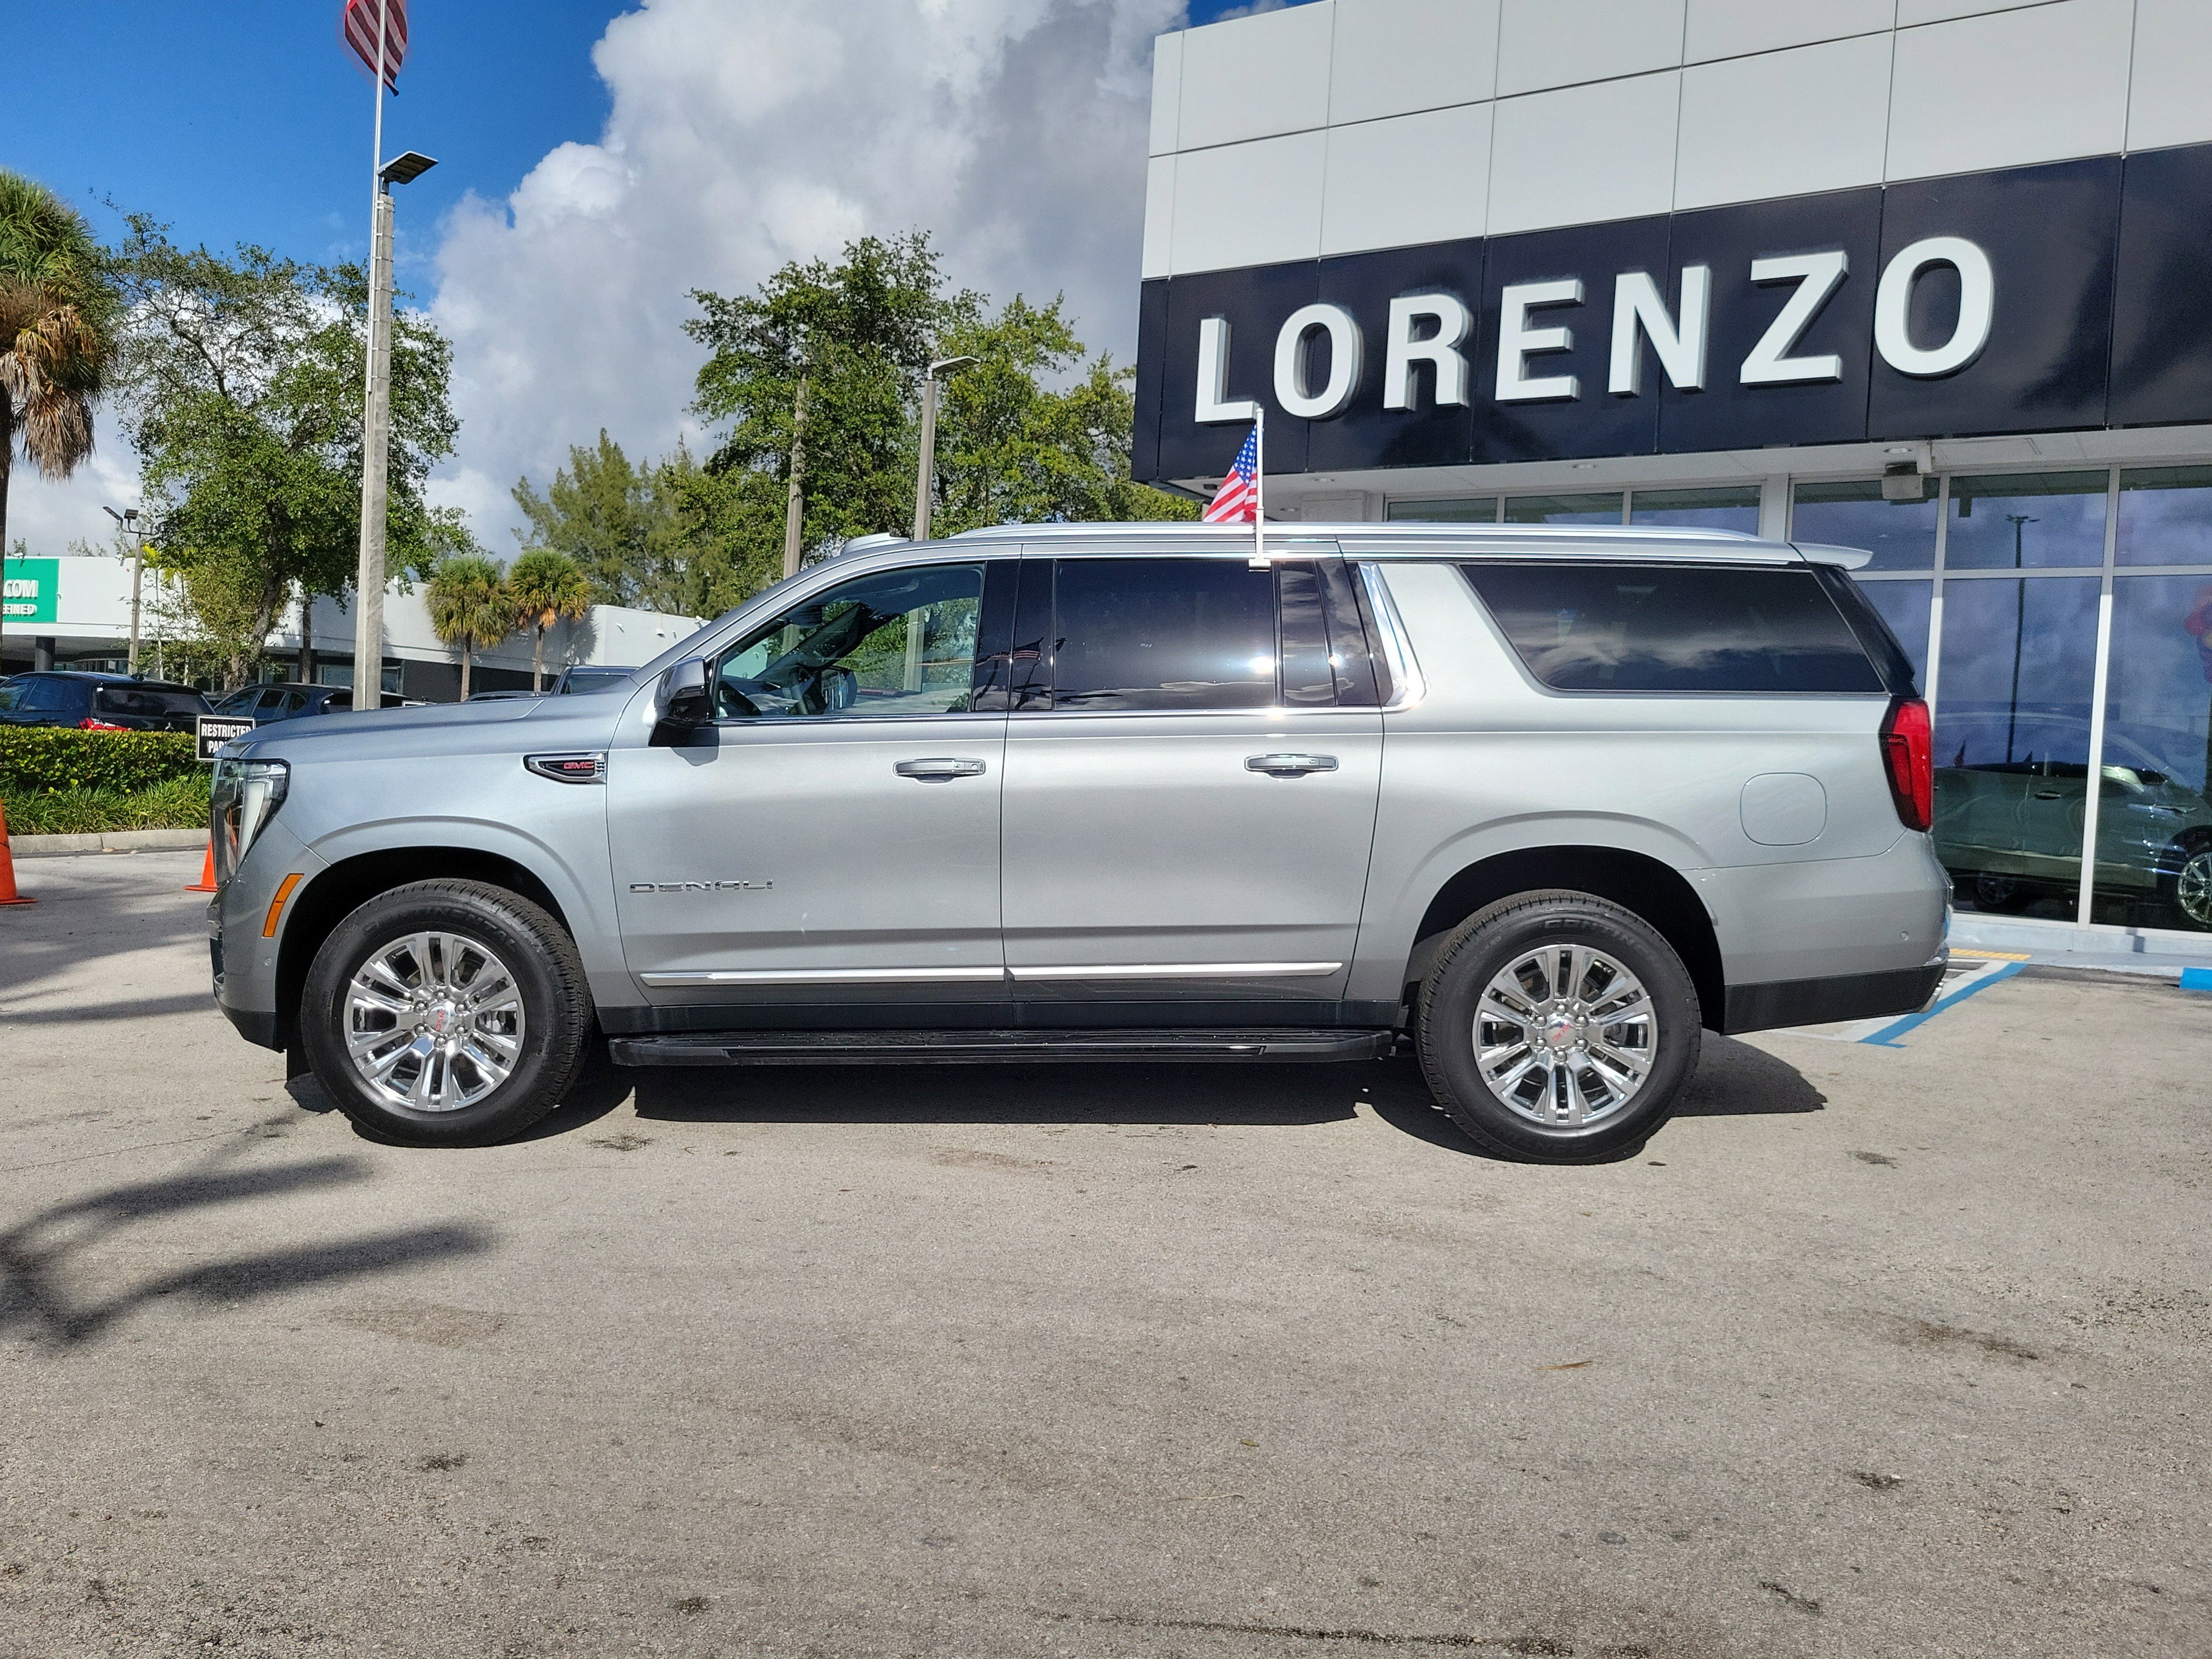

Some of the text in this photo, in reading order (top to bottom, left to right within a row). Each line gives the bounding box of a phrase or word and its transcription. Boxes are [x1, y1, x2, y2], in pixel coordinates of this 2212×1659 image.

[1194, 236, 1995, 424] LORENZO
[563, 761, 594, 770] GMC
[630, 879, 773, 893] DENALI
